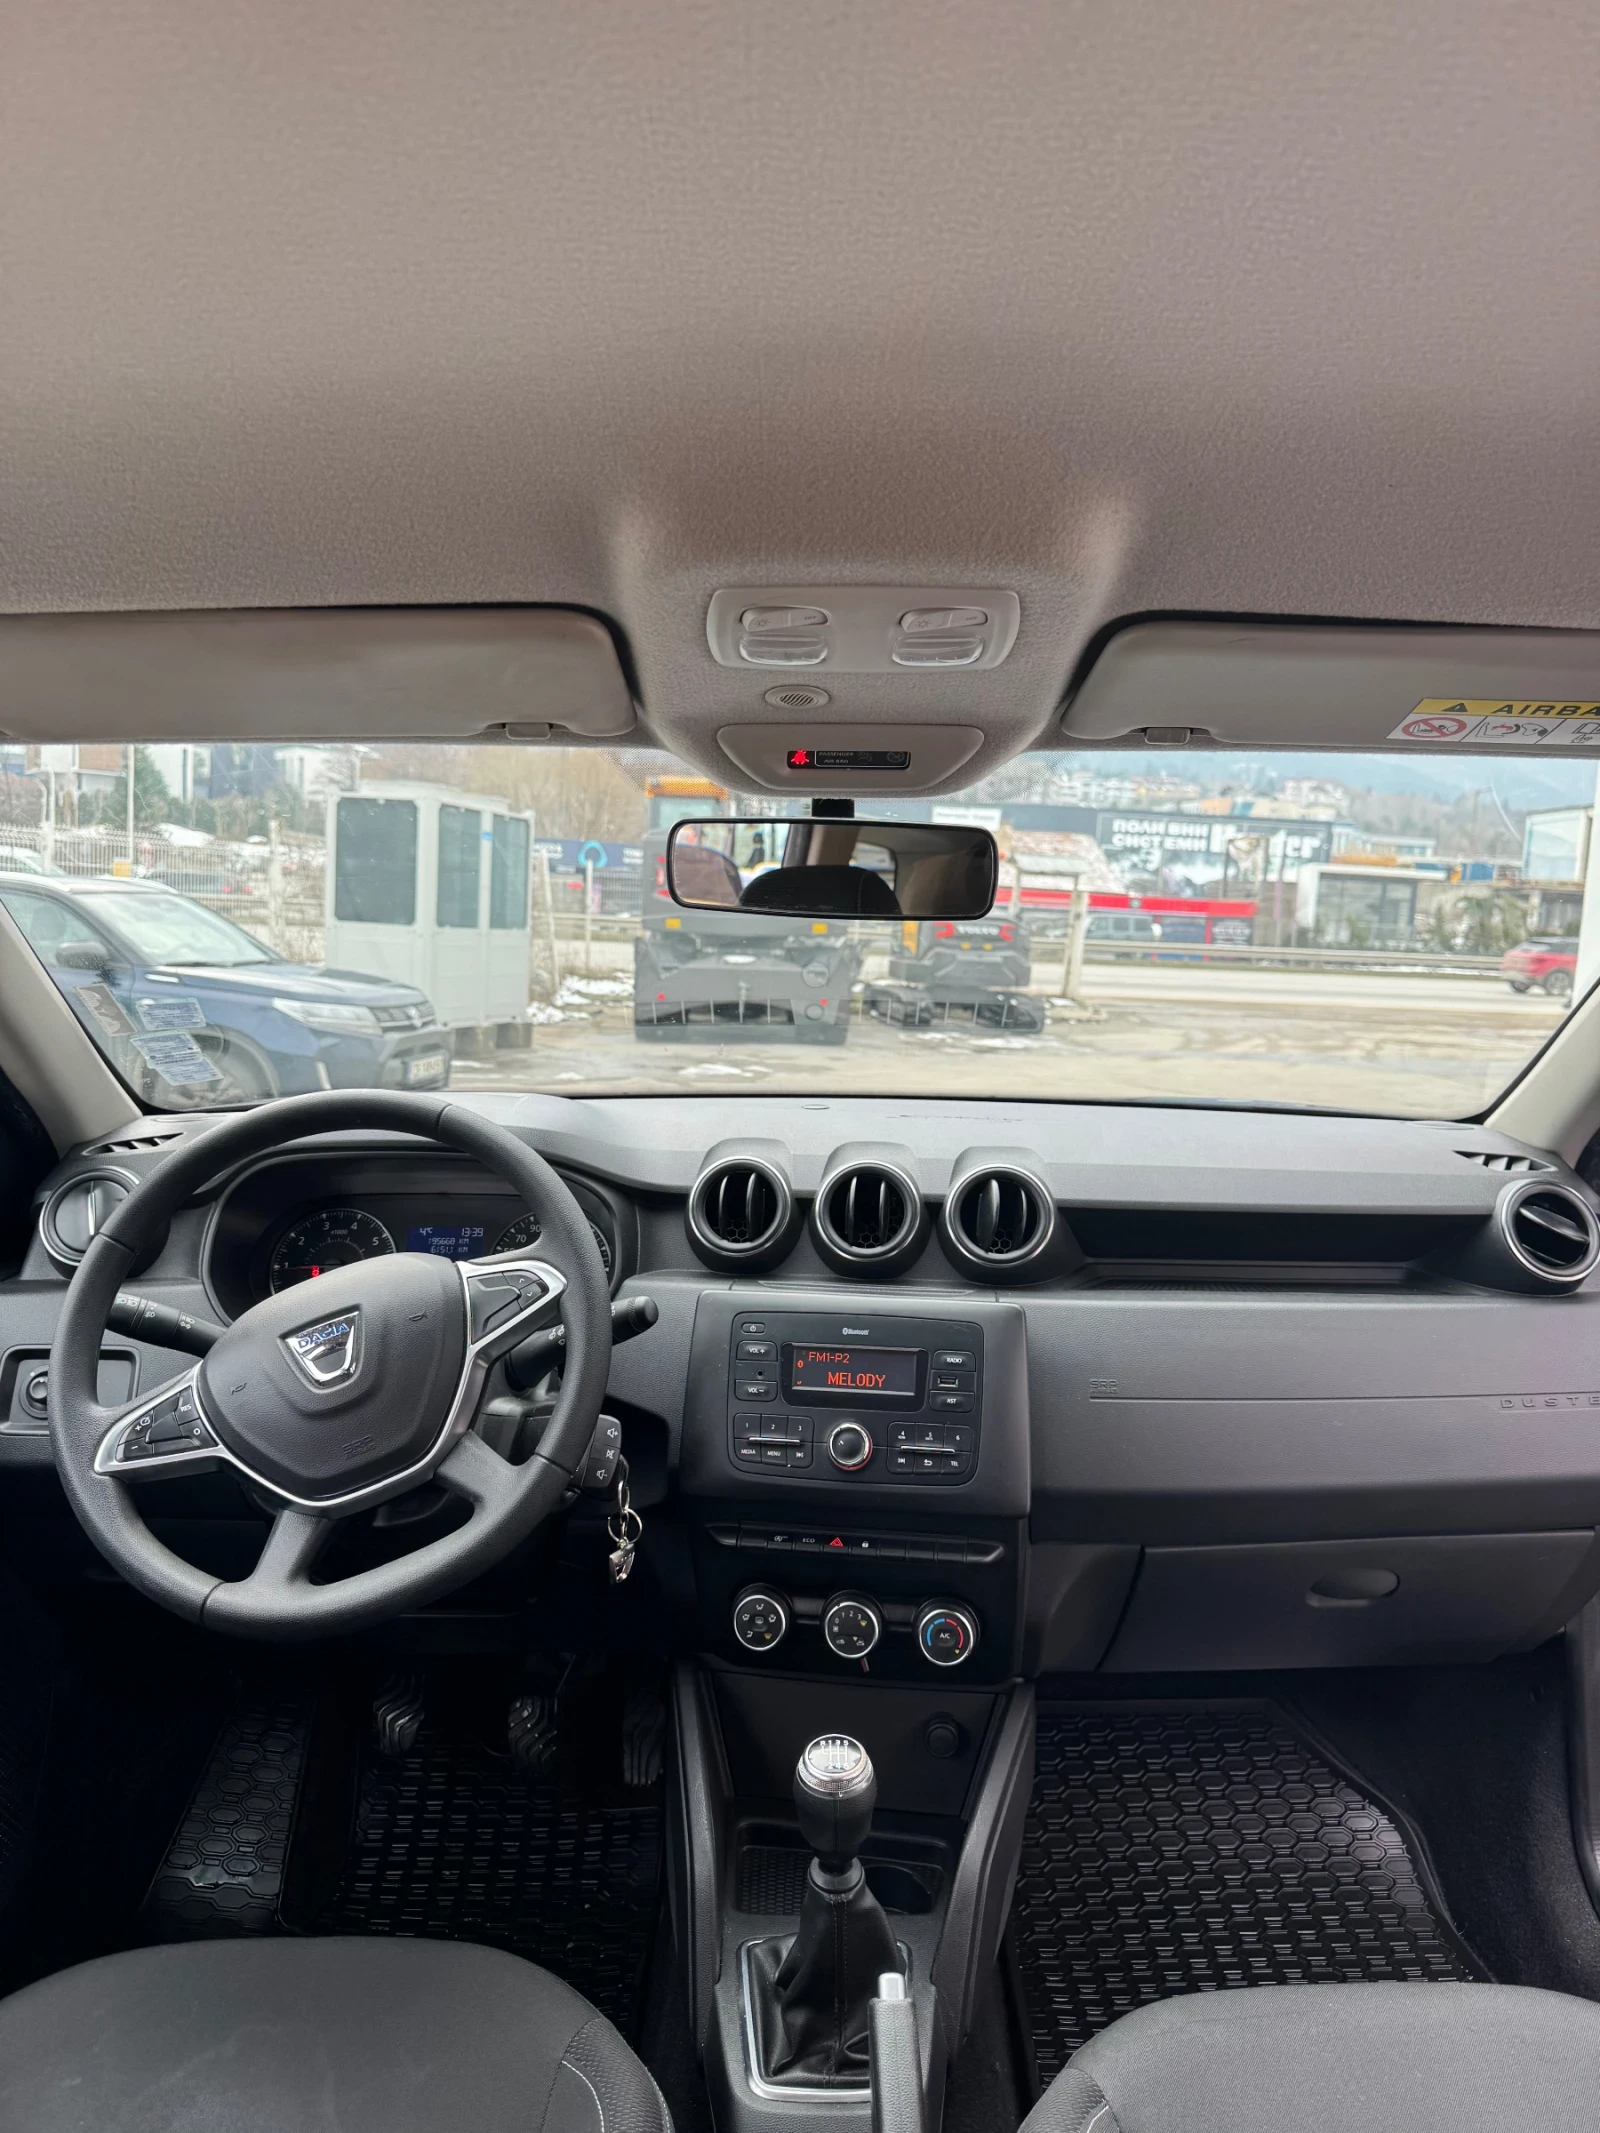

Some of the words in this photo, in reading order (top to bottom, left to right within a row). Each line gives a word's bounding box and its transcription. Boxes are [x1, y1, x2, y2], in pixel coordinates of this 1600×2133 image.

[323, 1222, 329, 1230] 3
[351, 1222, 358, 1230] 4
[461, 1227, 484, 1237] 13:39
[298, 1237, 305, 1246] 2
[372, 1237, 379, 1246] 5
[515, 1234, 527, 1243] 70
[297, 1322, 350, 1348] DACIA
[808, 1351, 850, 1364] FM1-P2
[827, 1371, 886, 1388] MELODY
[180, 1403, 192, 1413] RES
